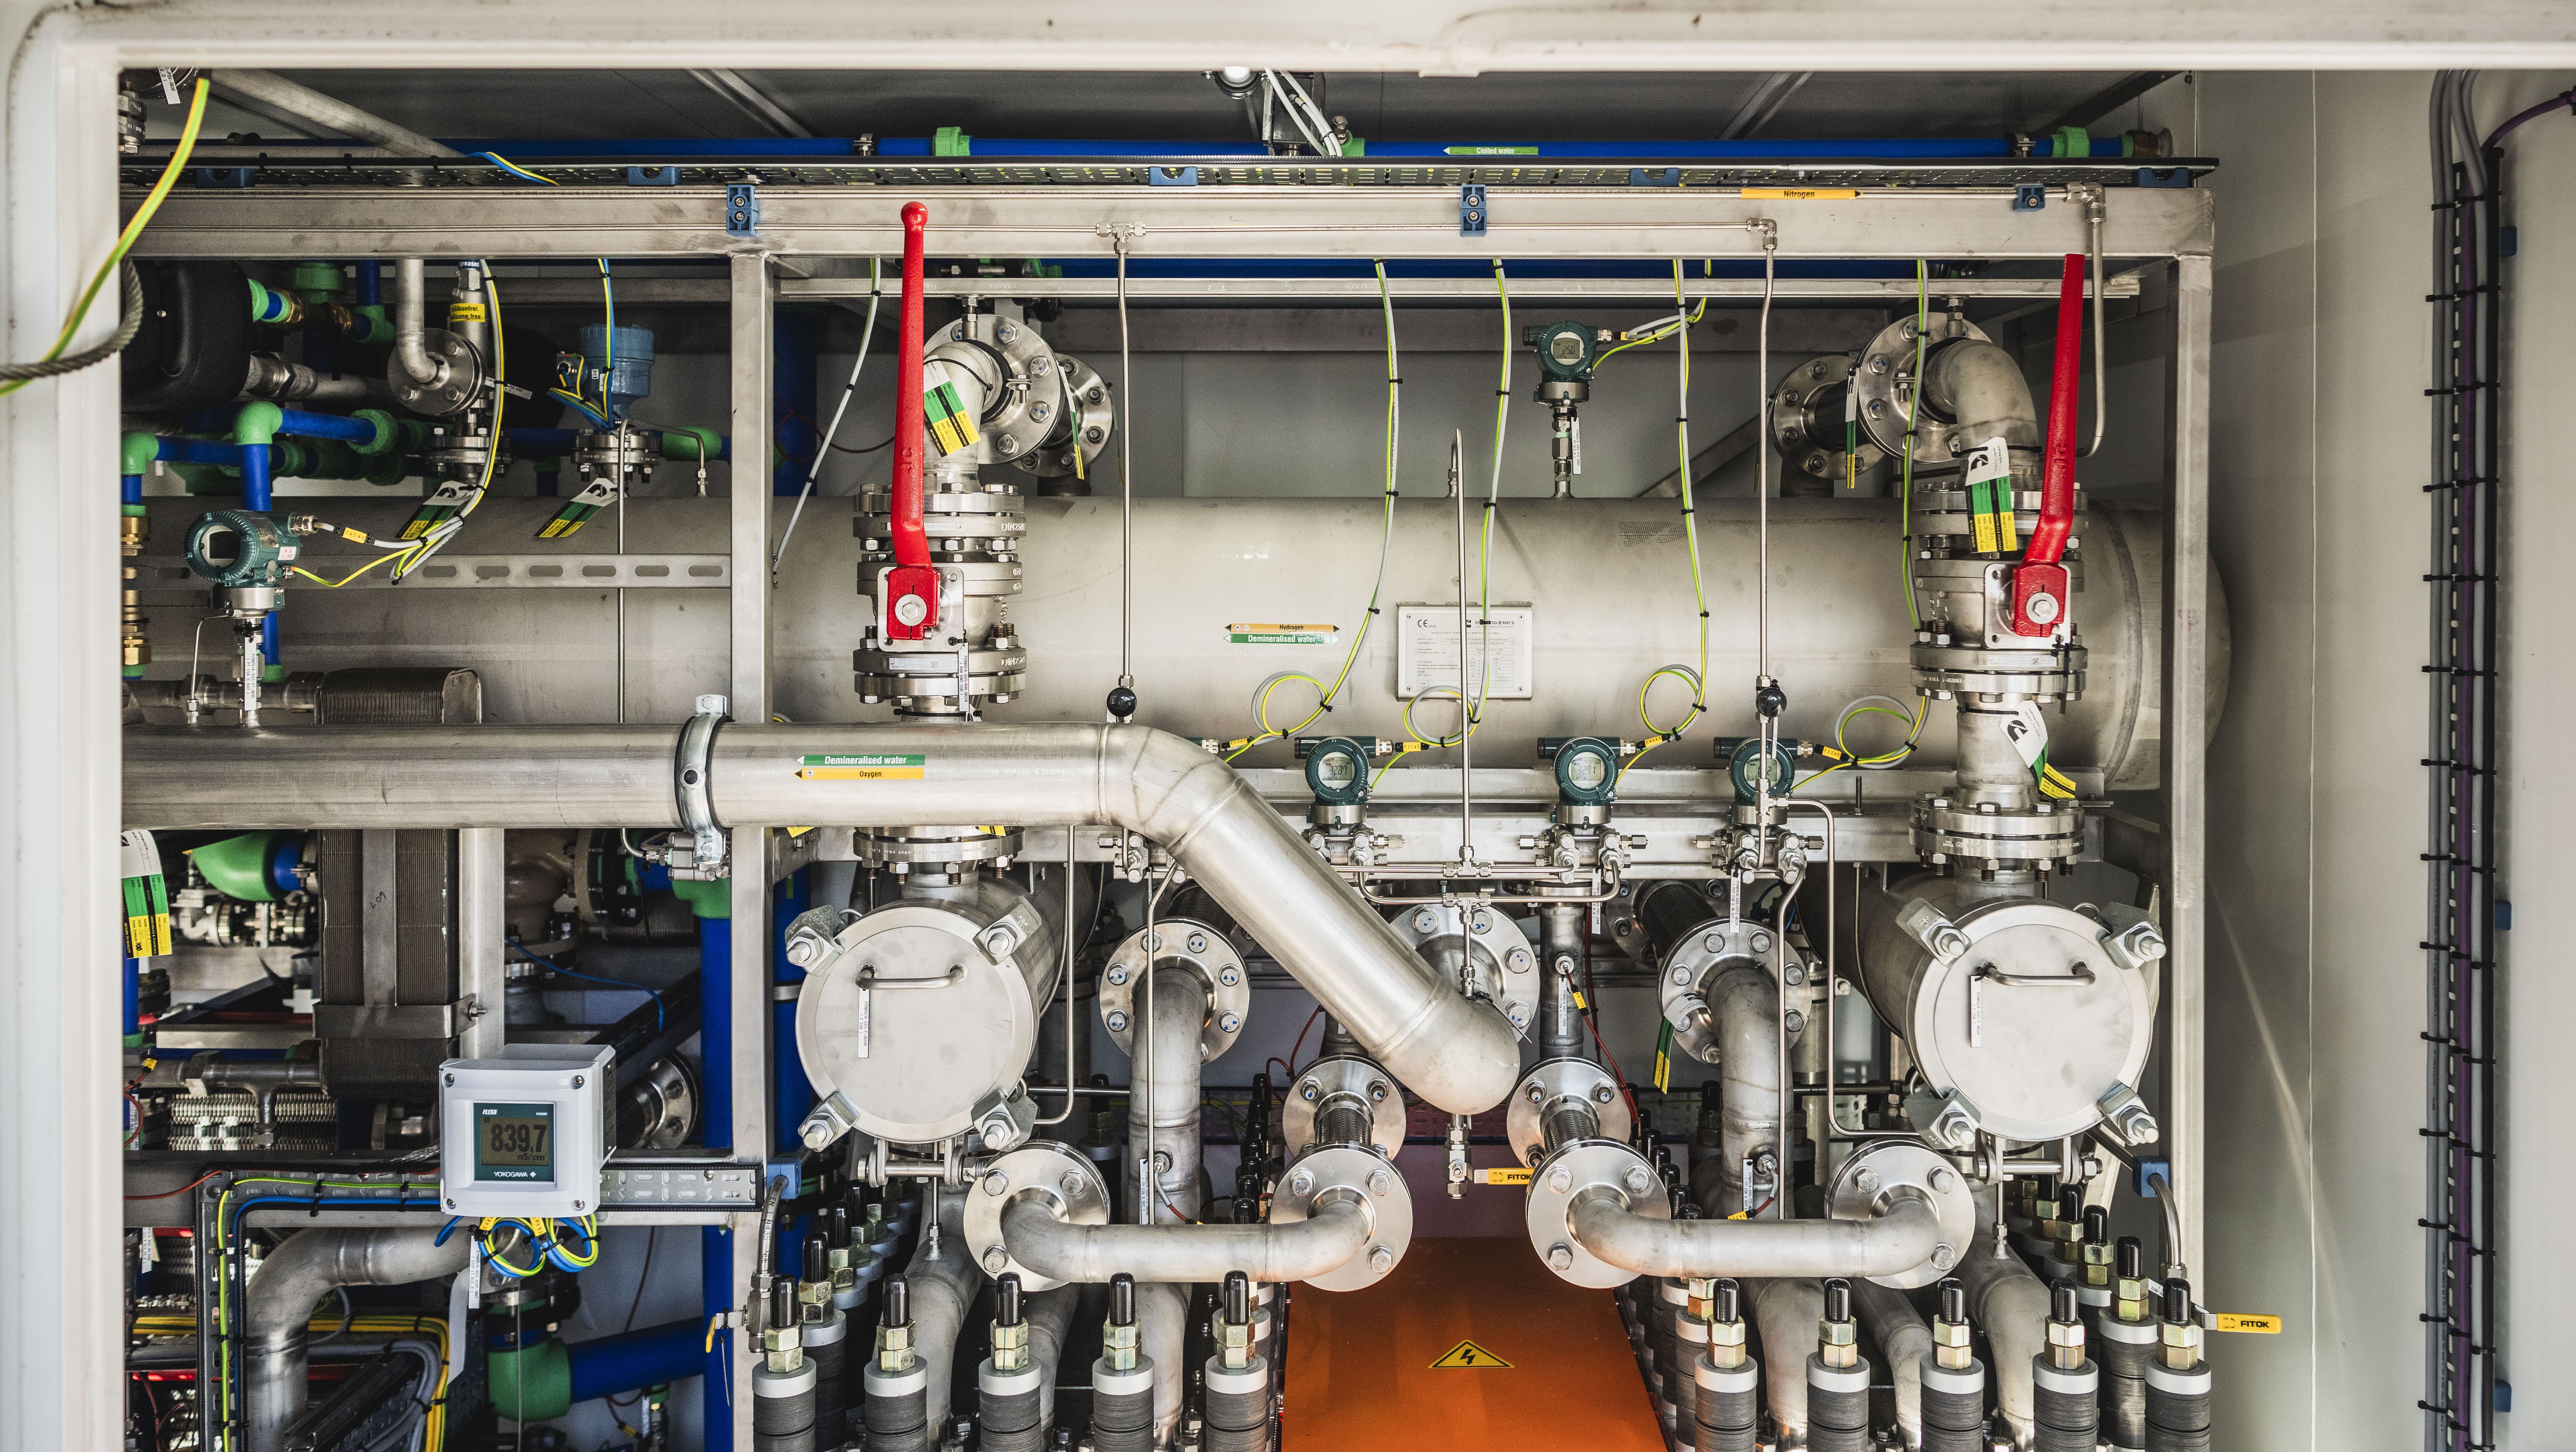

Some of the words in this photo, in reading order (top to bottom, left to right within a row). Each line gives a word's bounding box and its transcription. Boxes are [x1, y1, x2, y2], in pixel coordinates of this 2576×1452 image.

[1784, 190, 1815, 199] Nitrogen
[1248, 634, 1295, 643] Demineralised
[825, 756, 883, 765] Demineralised
[884, 757, 907, 765] water
[859, 770, 882, 779] Oxygen
[490, 1123, 547, 1153] 839.7
[517, 1153, 545, 1161] nS/cm
[768, 1196, 776, 1207] EN
